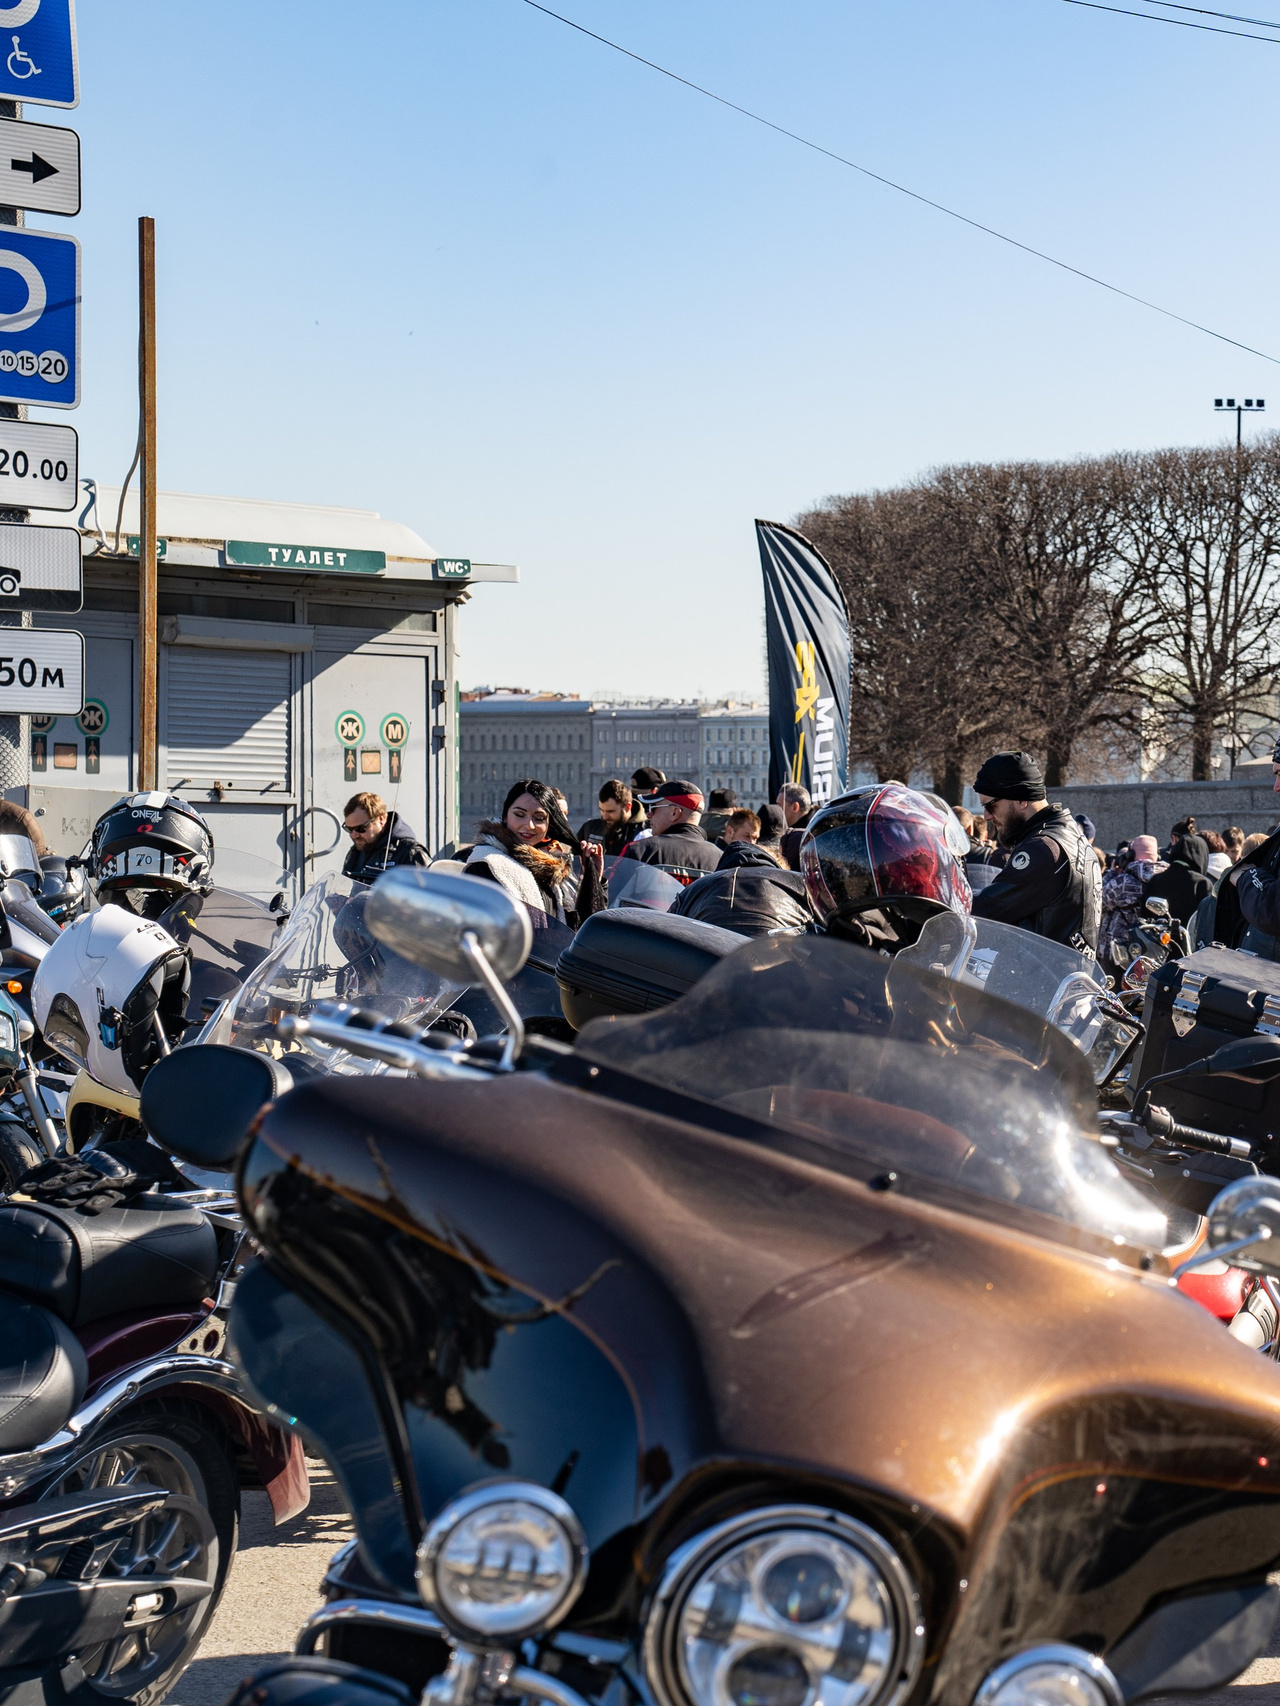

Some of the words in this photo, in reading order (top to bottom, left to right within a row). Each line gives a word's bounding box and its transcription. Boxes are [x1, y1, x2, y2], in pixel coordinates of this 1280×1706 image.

[1, 355, 14, 367] 10
[19, 356, 35, 371] 15
[41, 357, 65, 376] 20
[268, 548, 347, 566] ТУАЛЕТ
[135, 853, 153, 867] 70
